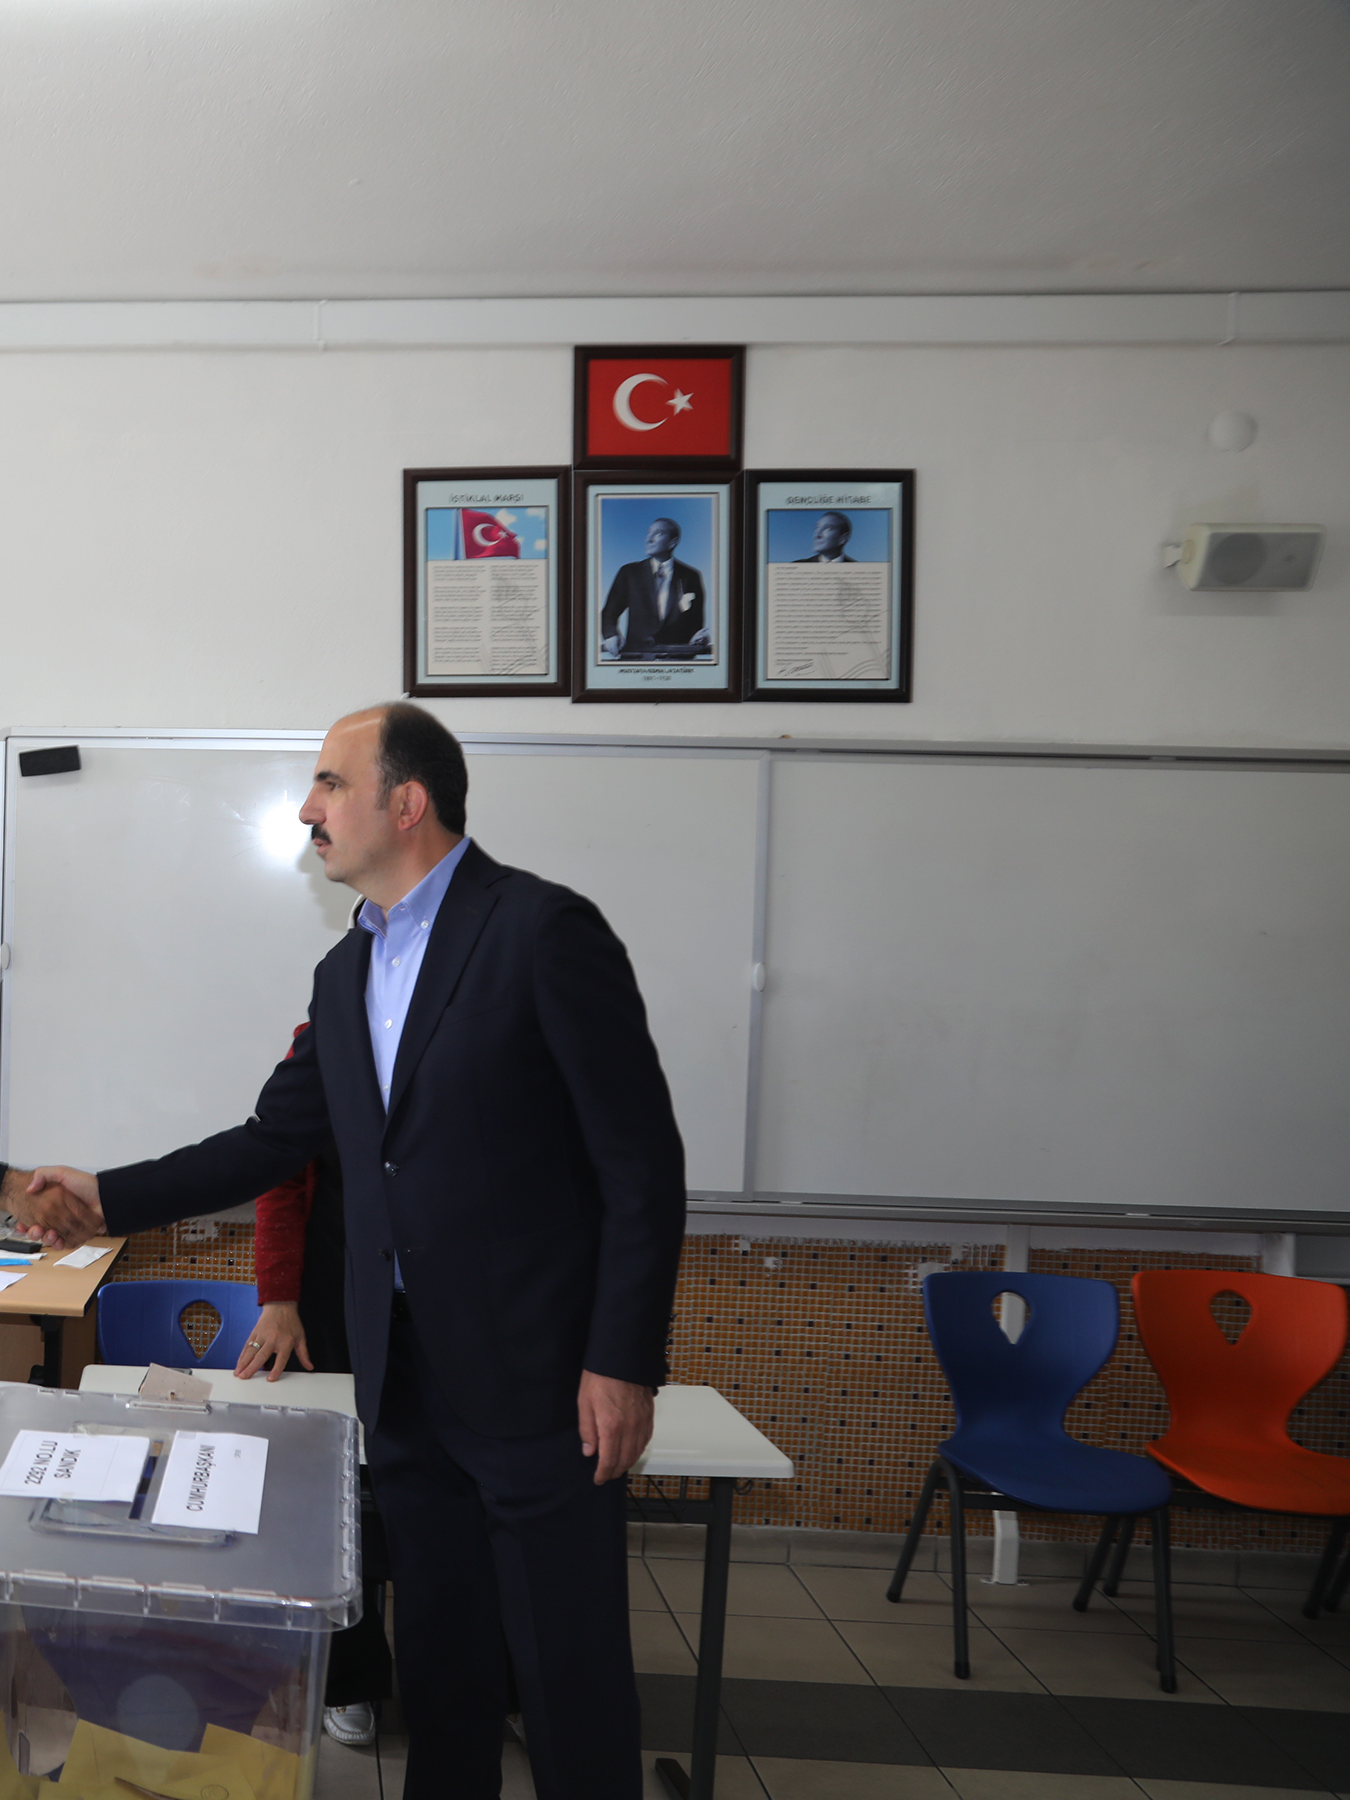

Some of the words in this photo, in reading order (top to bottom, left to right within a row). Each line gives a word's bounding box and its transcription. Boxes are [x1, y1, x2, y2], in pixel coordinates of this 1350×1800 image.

[24, 1467, 47, 1485] 2292
[53, 1448, 81, 1479] SANDIK
[186, 1444, 216, 1512] CUMHURBAŞKANI
